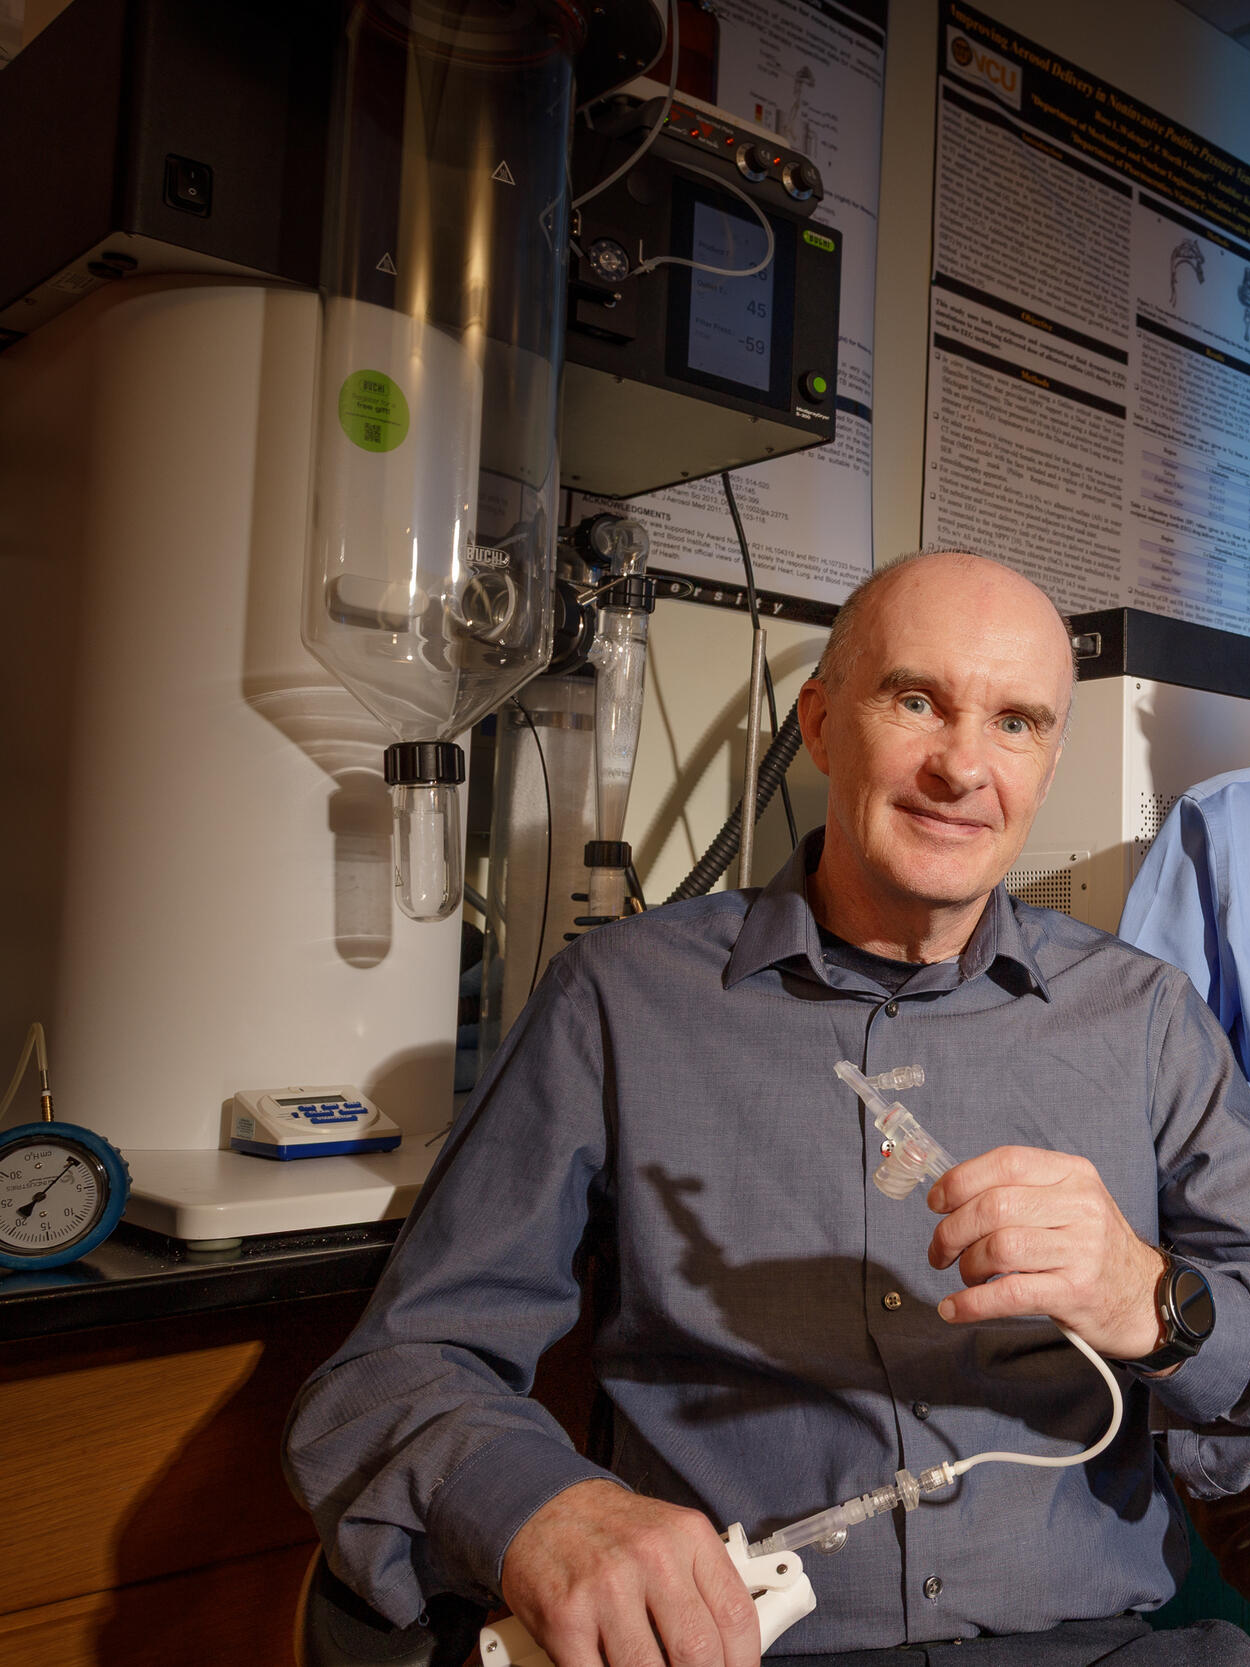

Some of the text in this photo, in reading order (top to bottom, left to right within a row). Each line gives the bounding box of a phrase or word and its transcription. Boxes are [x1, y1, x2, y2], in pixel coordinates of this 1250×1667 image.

[951, 2, 1009, 53] Improving
[1011, 39, 1051, 72] Aerosol
[1051, 61, 1093, 99] Delivery
[1095, 87, 1106, 104] in
[974, 50, 1017, 92] VCU
[746, 300, 767, 319] 45
[737, 336, 765, 356] -59
[467, 546, 503, 564] BUCHI
[10, 1170, 22, 1180] 30
[76, 1183, 82, 1193] 5
[1, 1198, 13, 1209] 25
[63, 1207, 74, 1217] 10
[15, 1216, 28, 1227] 20
[40, 1221, 51, 1232] 15
